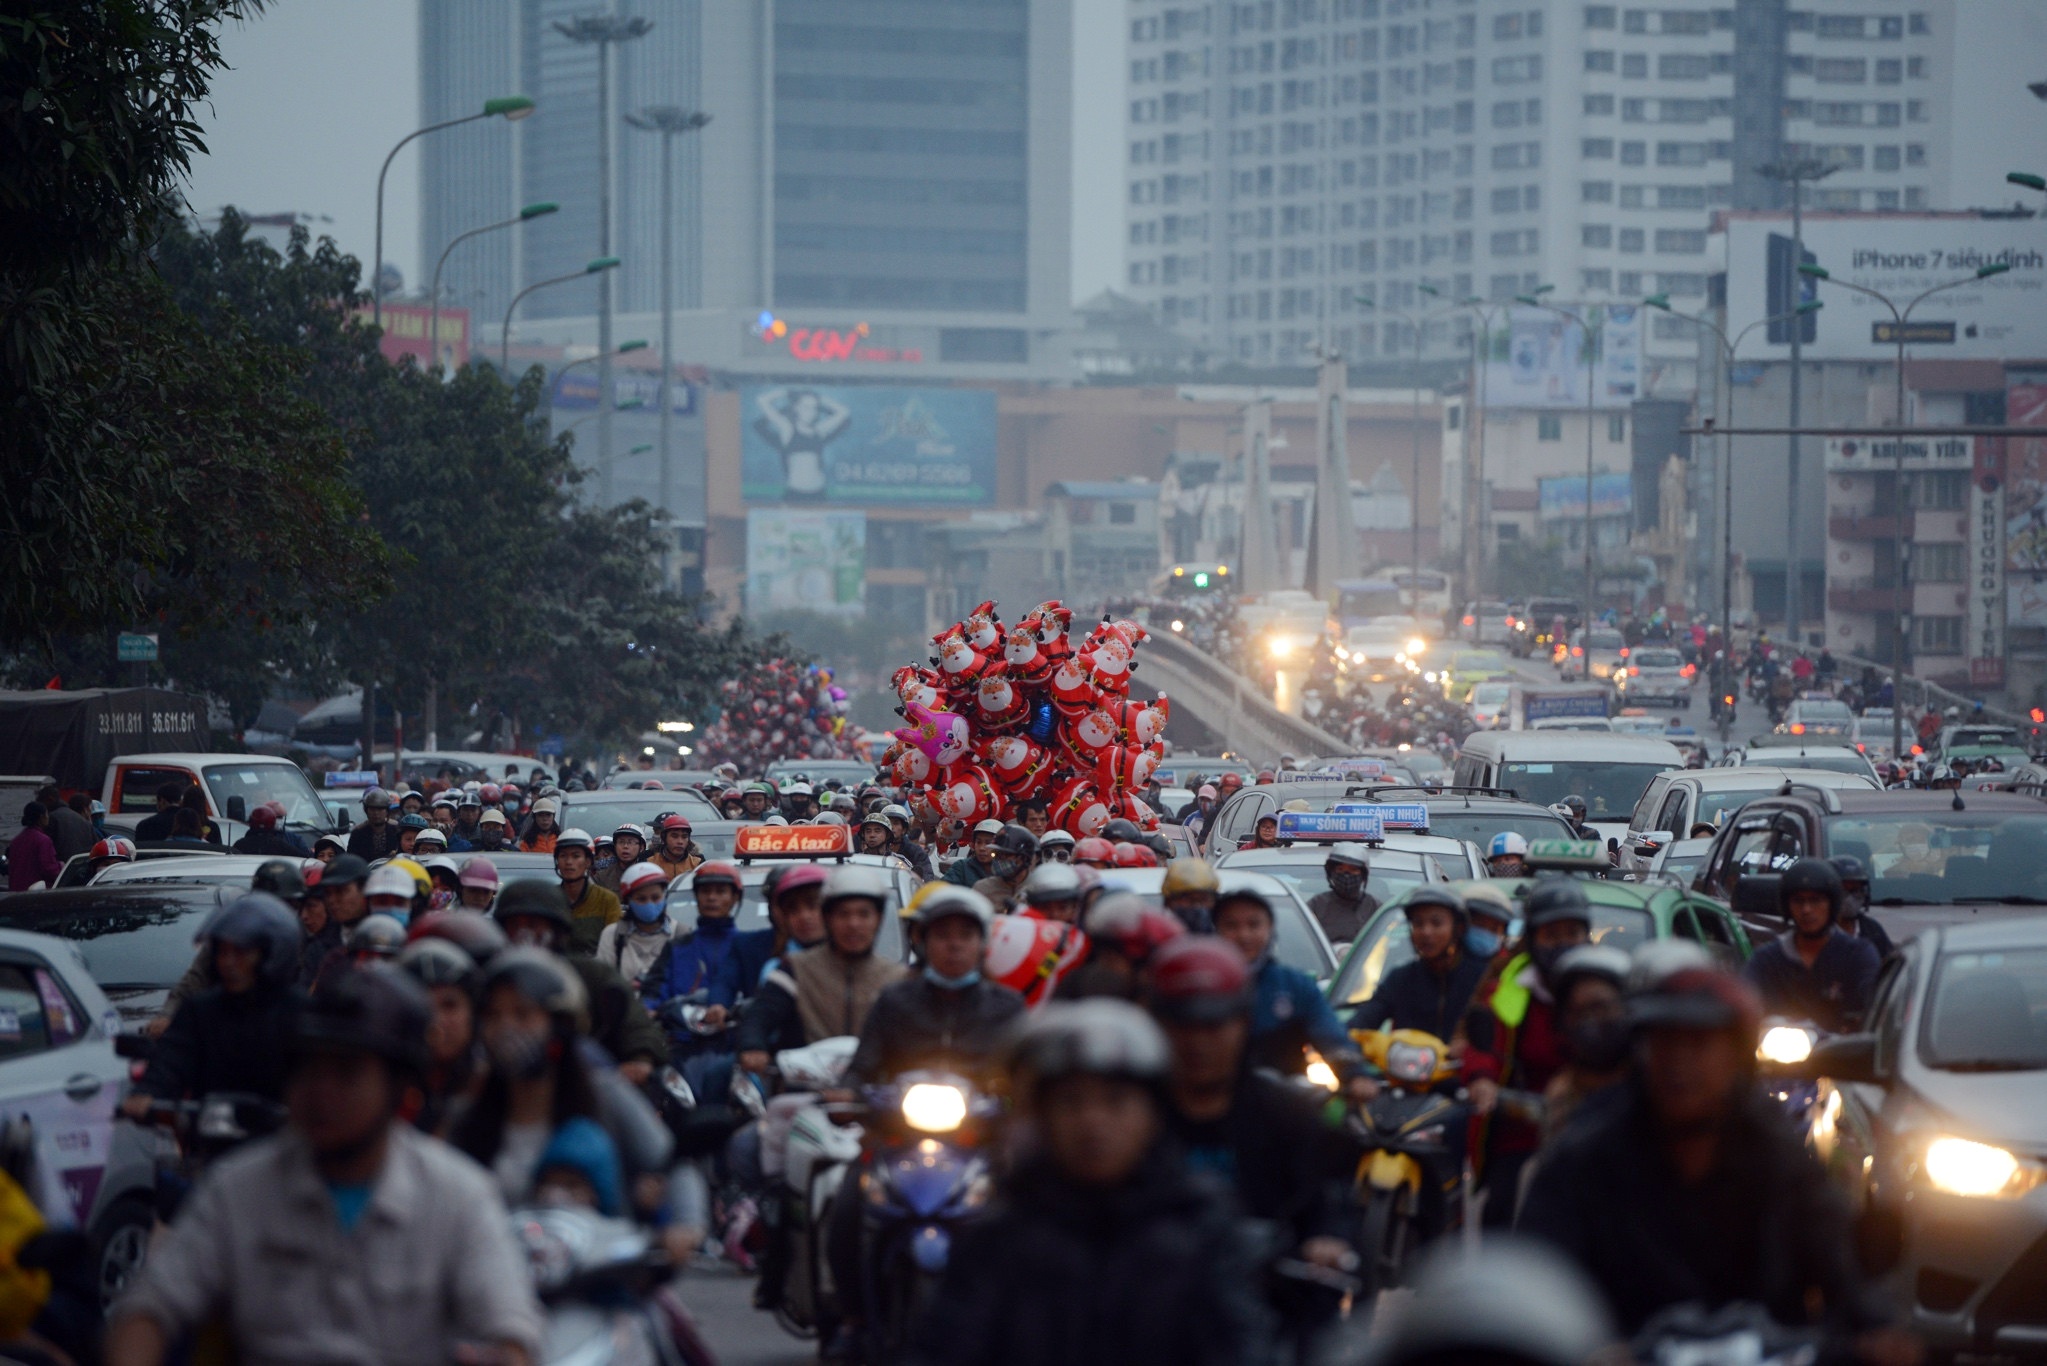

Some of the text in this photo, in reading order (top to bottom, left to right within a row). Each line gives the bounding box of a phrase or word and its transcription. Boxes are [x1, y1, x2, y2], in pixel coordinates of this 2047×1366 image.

[1852, 249, 1926, 269] iPhone
[1930, 250, 1943, 269] 7
[1300, 814, 1379, 834] TAXI SÔNG NHUỆ
[1534, 840, 1597, 858] TAXI
